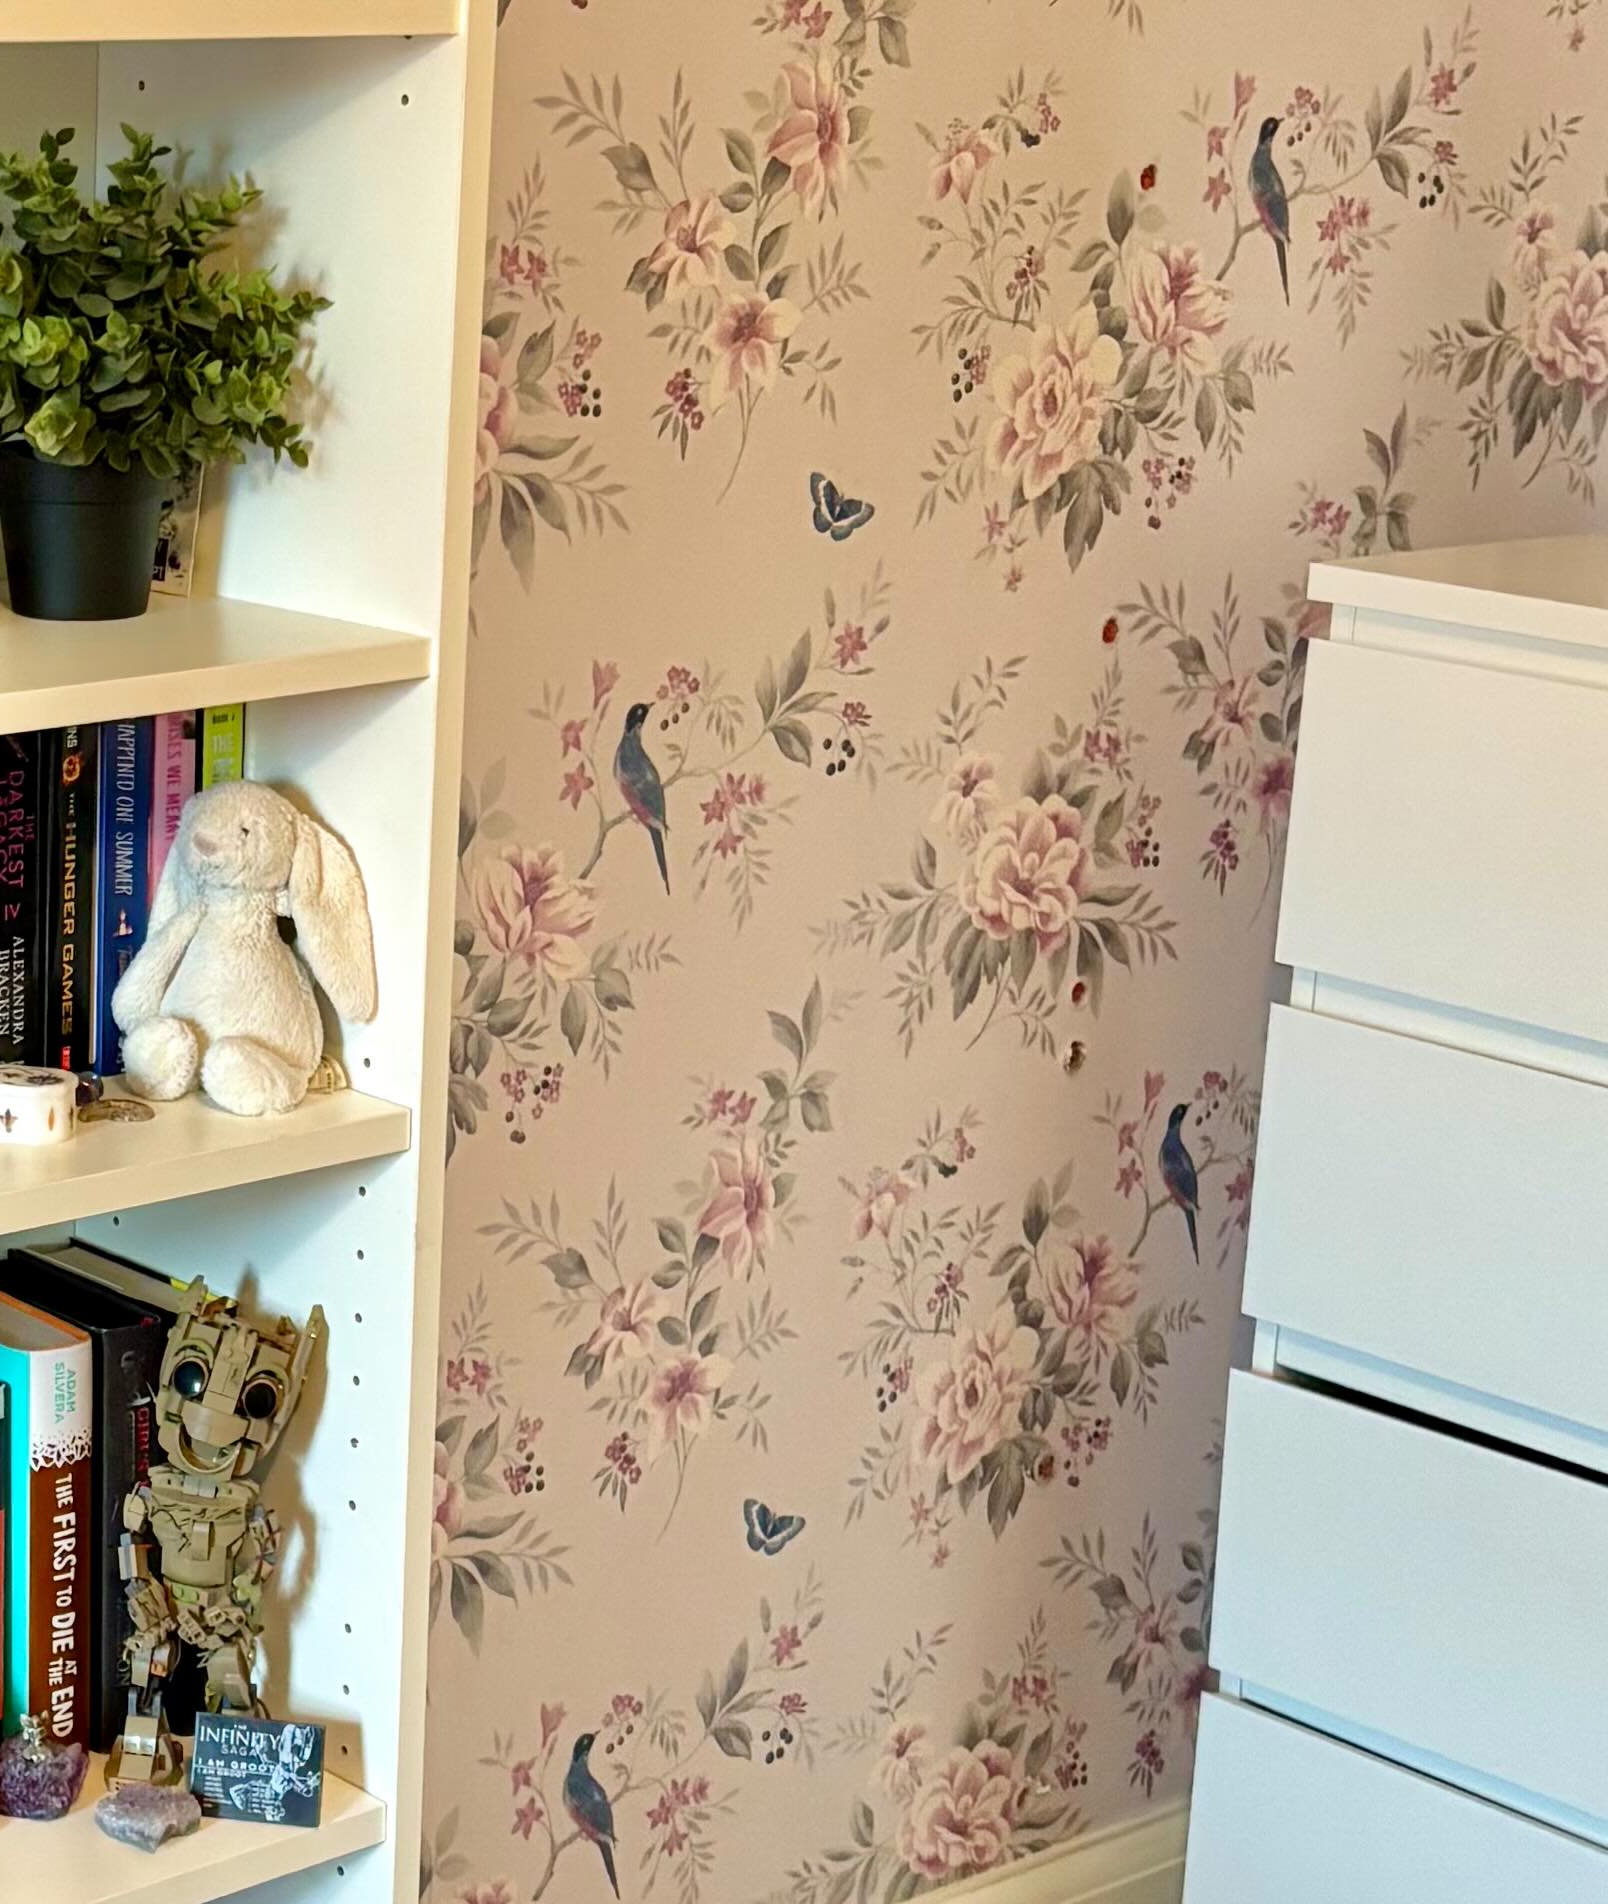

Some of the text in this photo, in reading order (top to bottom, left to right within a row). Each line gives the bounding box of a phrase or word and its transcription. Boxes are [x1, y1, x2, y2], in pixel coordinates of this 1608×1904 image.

[8, 770, 24, 889] DARKEST
[24, 815, 35, 841] THE
[63, 822, 77, 935] HUNGER
[12, 935, 26, 1045] ALEXANDRA
[62, 943, 76, 1036] GAMES
[53, 1362, 64, 1425] SILVERA
[65, 1369, 76, 1413] ADAM
[50, 1472, 77, 1654] THE FIRST TO DIE
[47, 1656, 61, 1687] THE
[62, 1659, 77, 1675] AT
[51, 1685, 74, 1738] END
[200, 1726, 281, 1751] INFINITY
[221, 1745, 258, 1756] SAGA
[231, 1762, 275, 1772] GROOT
